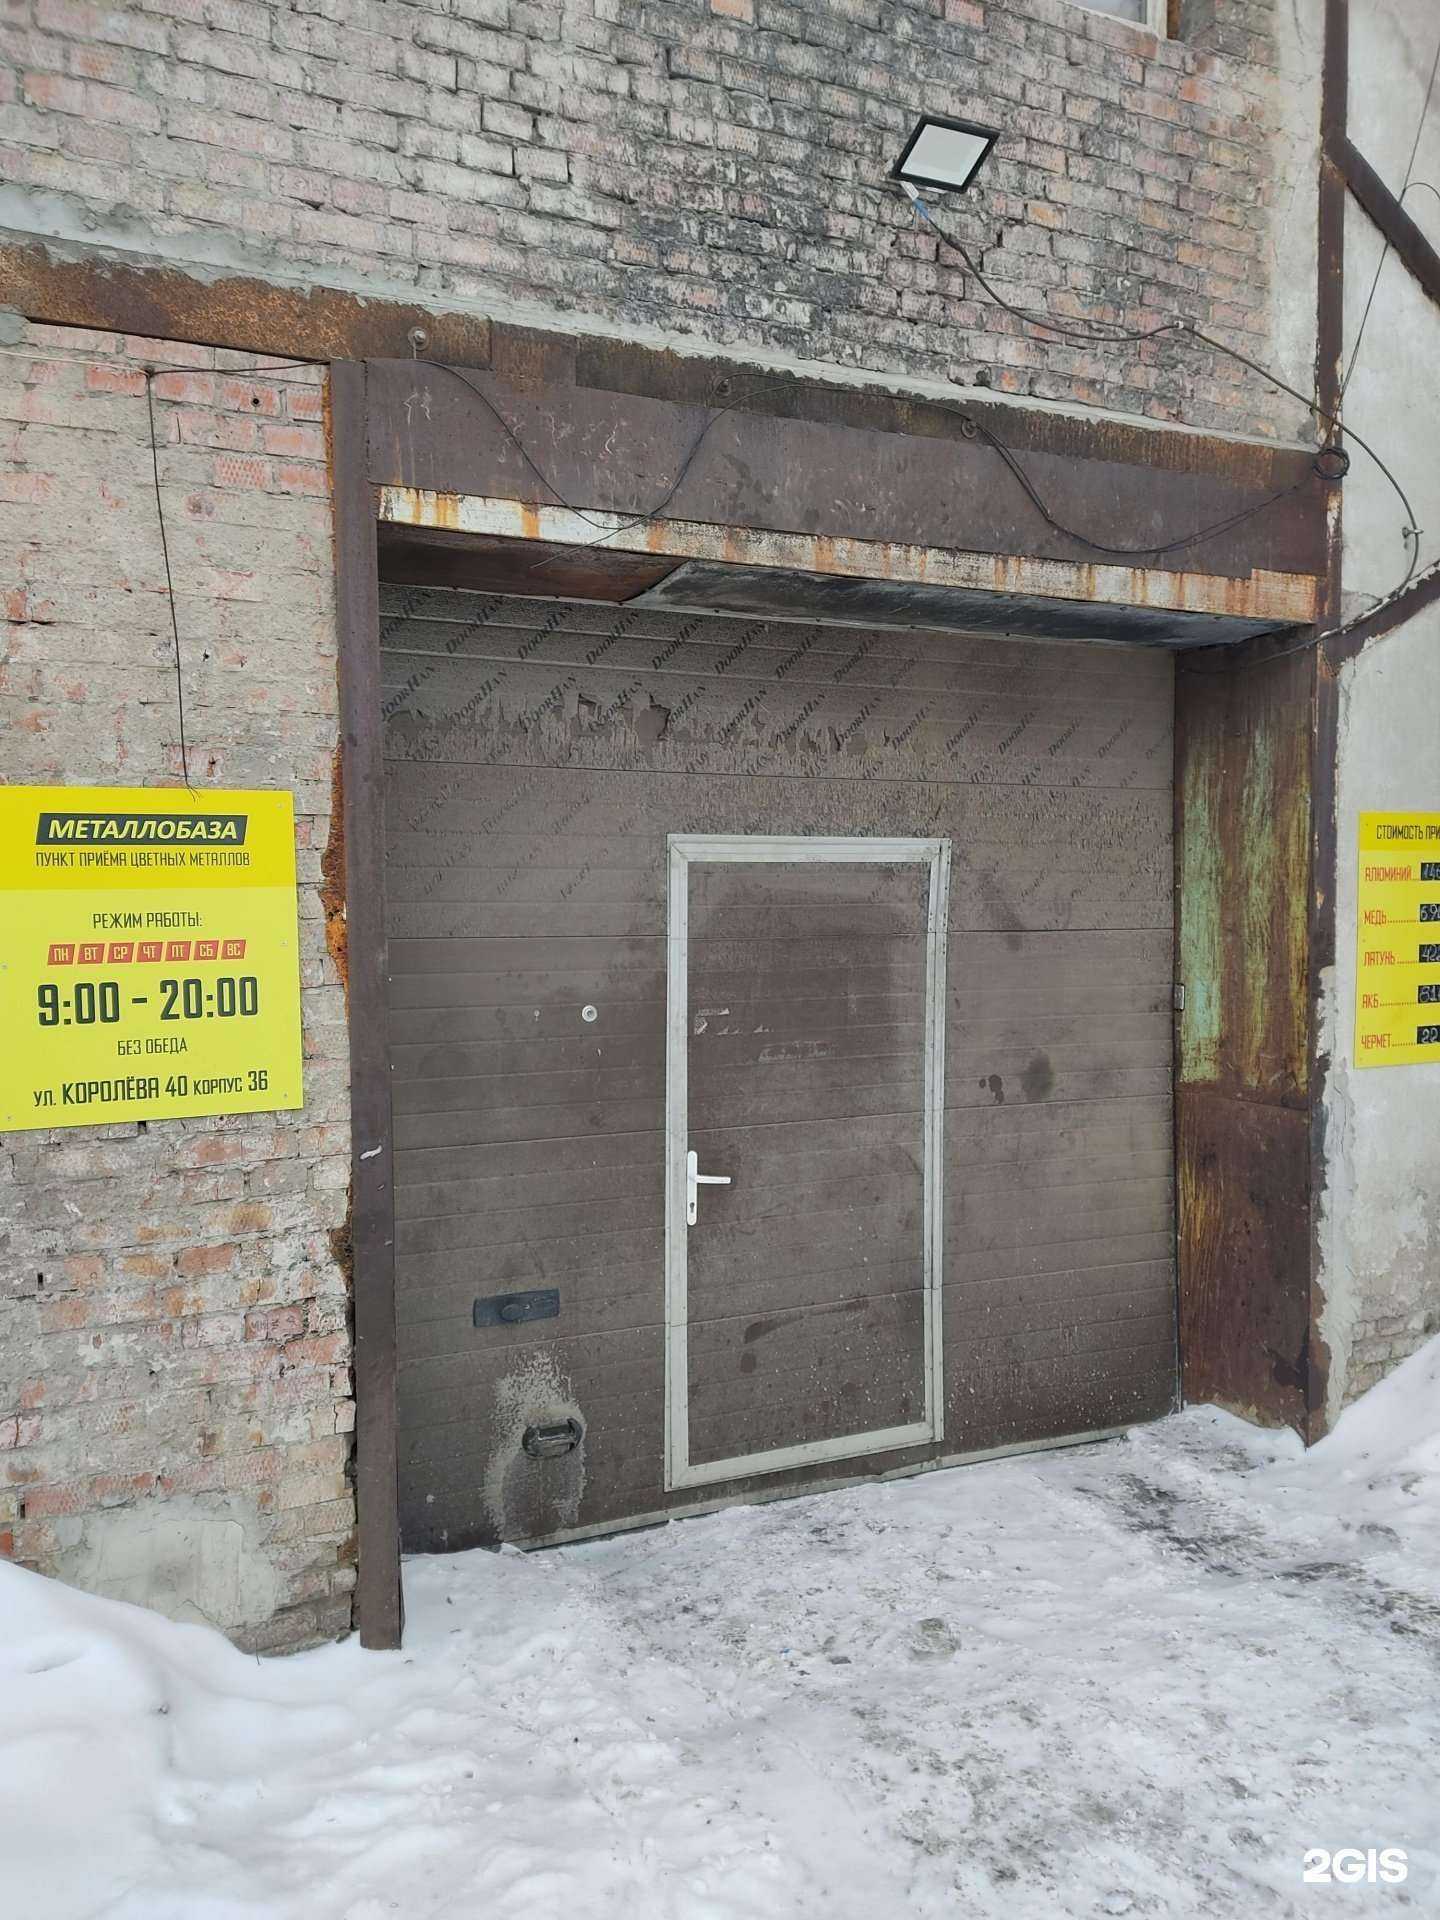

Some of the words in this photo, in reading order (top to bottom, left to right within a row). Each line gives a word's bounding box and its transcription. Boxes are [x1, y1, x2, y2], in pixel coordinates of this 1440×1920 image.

[48, 819, 238, 840] МЕТАЛЛОБАЗА
[1376, 824, 1424, 840] СТОИМОСТЬ
[36, 852, 75, 867] ПУНКТ
[79, 850, 127, 866] ПРИЁМА
[130, 851, 187, 868] ЦВЕТНЫХ
[189, 851, 250, 866] МЕТАЛЛОВ
[93, 913, 143, 929] РЕЖИМ
[146, 911, 202, 928] РАБОТЫ:
[1364, 909, 1387, 926] МЕДЬ
[1421, 904, 1440, 921] 69
[54, 948, 69, 961] ПН
[84, 947, 98, 961] ВТ
[113, 946, 129, 960] СР
[143, 945, 157, 959] ЧТ
[171, 944, 185, 958] ПТ
[199, 944, 213, 957] СБ
[227, 943, 240, 957] ВС
[37, 982, 120, 1026] 9:00
[159, 976, 259, 1021] 20:00
[1362, 993, 1379, 1009] АКБ
[117, 1040, 141, 1056] БЕЗ
[146, 1037, 188, 1055] ОБЕДА
[1361, 1033, 1392, 1050] ЧЕРМЕТ
[62, 1076, 160, 1104] КОРОЛЁВА
[165, 1075, 188, 1097] 40
[193, 1077, 242, 1095] КОРПУС
[247, 1070, 268, 1091] 36
